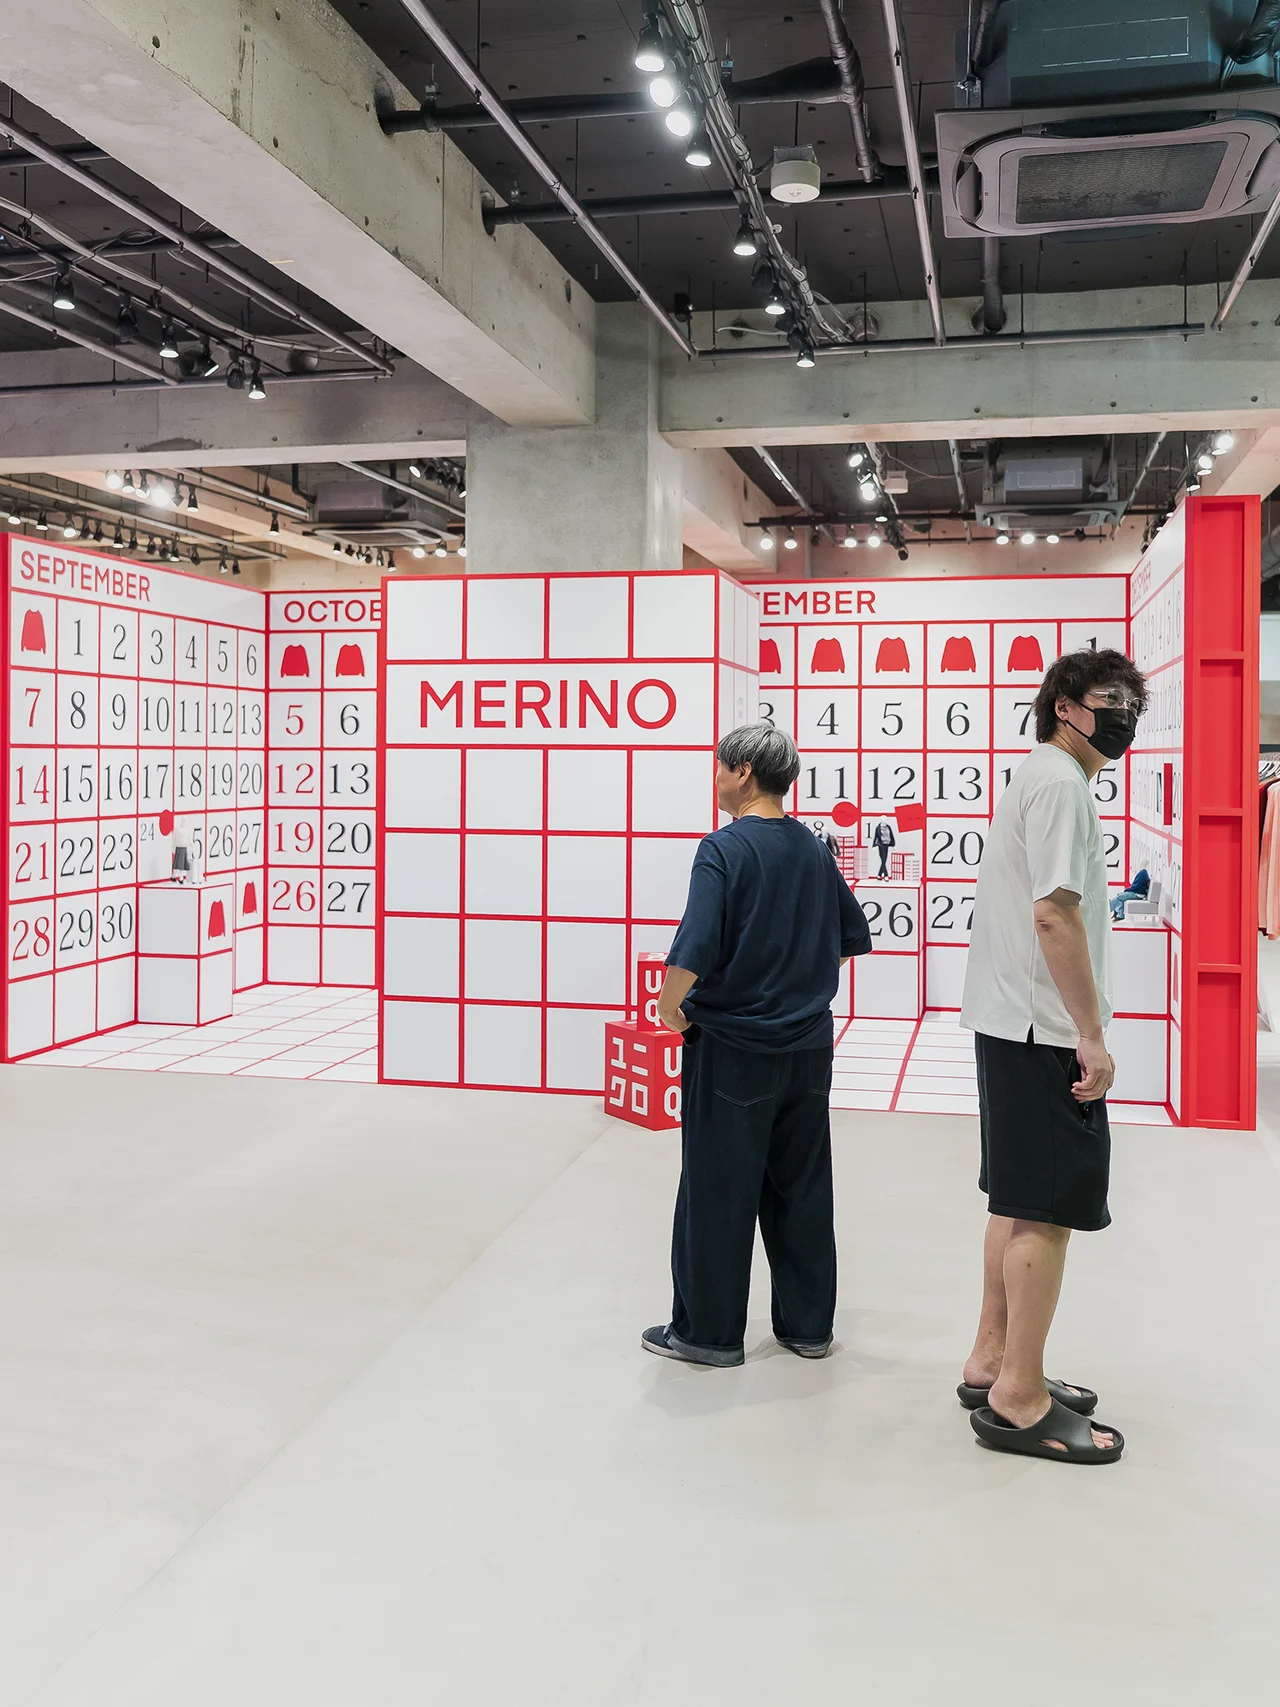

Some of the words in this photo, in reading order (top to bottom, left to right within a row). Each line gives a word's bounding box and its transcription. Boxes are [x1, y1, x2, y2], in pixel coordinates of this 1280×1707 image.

[20, 551, 151, 602] SEPTEMBER
[757, 590, 876, 615] EMBER
[74, 619, 83, 656] 1
[113, 624, 127, 660] 2
[150, 629, 164, 665] 3
[185, 635, 198, 669] 4
[217, 640, 229, 672] 5
[246, 644, 257, 675] 6
[24, 688, 41, 728] 7
[70, 691, 86, 729] 8
[112, 694, 127, 730] 9
[143, 697, 169, 732] 10
[180, 700, 201, 734] 11
[211, 702, 234, 734] 12
[241, 704, 261, 735] 13
[285, 704, 304, 736] 5
[339, 704, 360, 735] 6
[420, 679, 677, 729] MERINO
[816, 703, 839, 736] 4
[882, 702, 903, 736] 5
[946, 702, 970, 736] 6
[1013, 703, 1034, 735] 7
[16, 765, 49, 805] 14
[62, 764, 93, 803] 15
[104, 764, 133, 800] 16
[143, 764, 169, 799] 17
[178, 763, 202, 797] 18
[211, 763, 233, 796] 19
[240, 763, 263, 795] 20
[275, 763, 315, 794] 12
[330, 763, 370, 795] 13
[806, 766, 849, 799] 11
[868, 766, 916, 800] 12
[934, 767, 982, 801] 13
[15, 842, 49, 883] 21
[60, 837, 94, 877] 22
[102, 833, 133, 871] 23
[140, 823, 155, 841] 24
[209, 824, 234, 858] 26
[239, 823, 262, 854] 27
[274, 822, 314, 853] 19
[327, 822, 371, 854] 20
[932, 830, 984, 865] 20
[272, 880, 316, 912] 26
[327, 881, 371, 913] 27
[13, 917, 50, 962] 28
[59, 909, 94, 951] 29
[101, 903, 133, 943] 30
[861, 902, 913, 937] 26
[931, 895, 976, 930] 27
